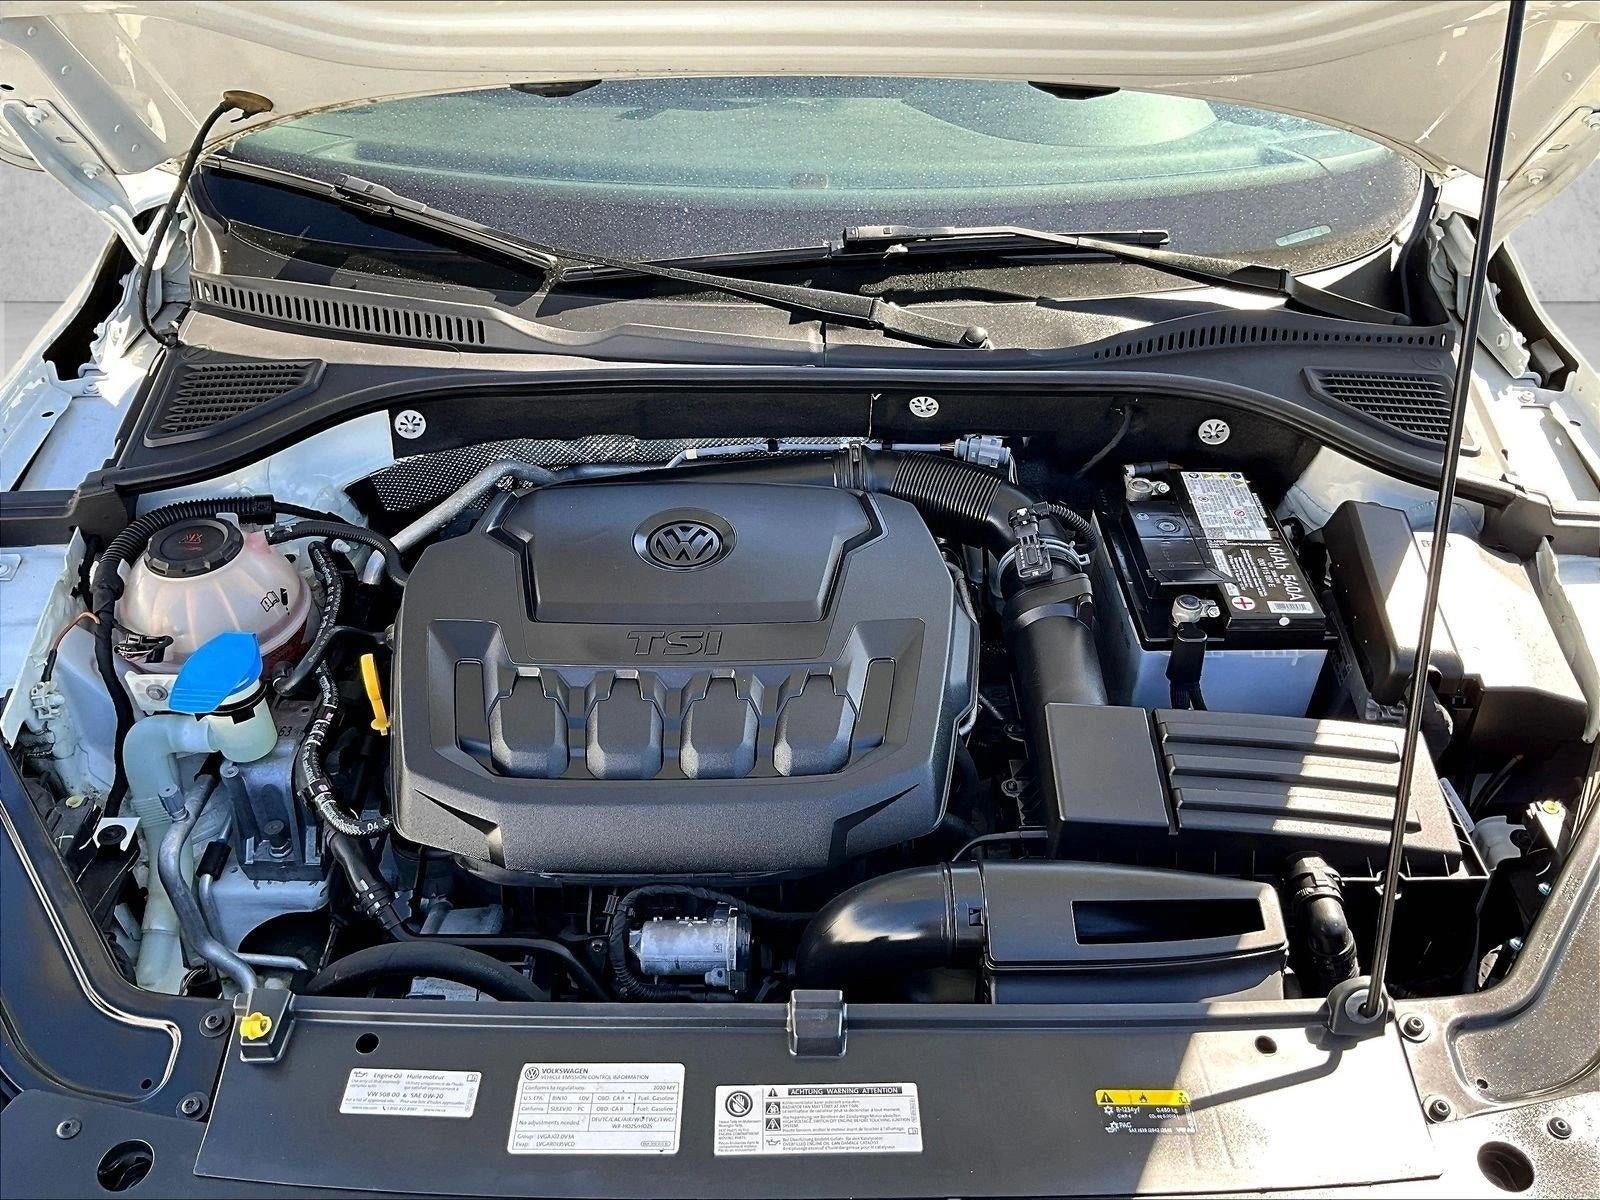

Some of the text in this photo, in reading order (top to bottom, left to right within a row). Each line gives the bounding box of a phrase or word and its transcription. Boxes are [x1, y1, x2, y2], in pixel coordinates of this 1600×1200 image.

[1267, 546, 1305, 600] 61Ah 540A
[627, 631, 722, 656] TSI
